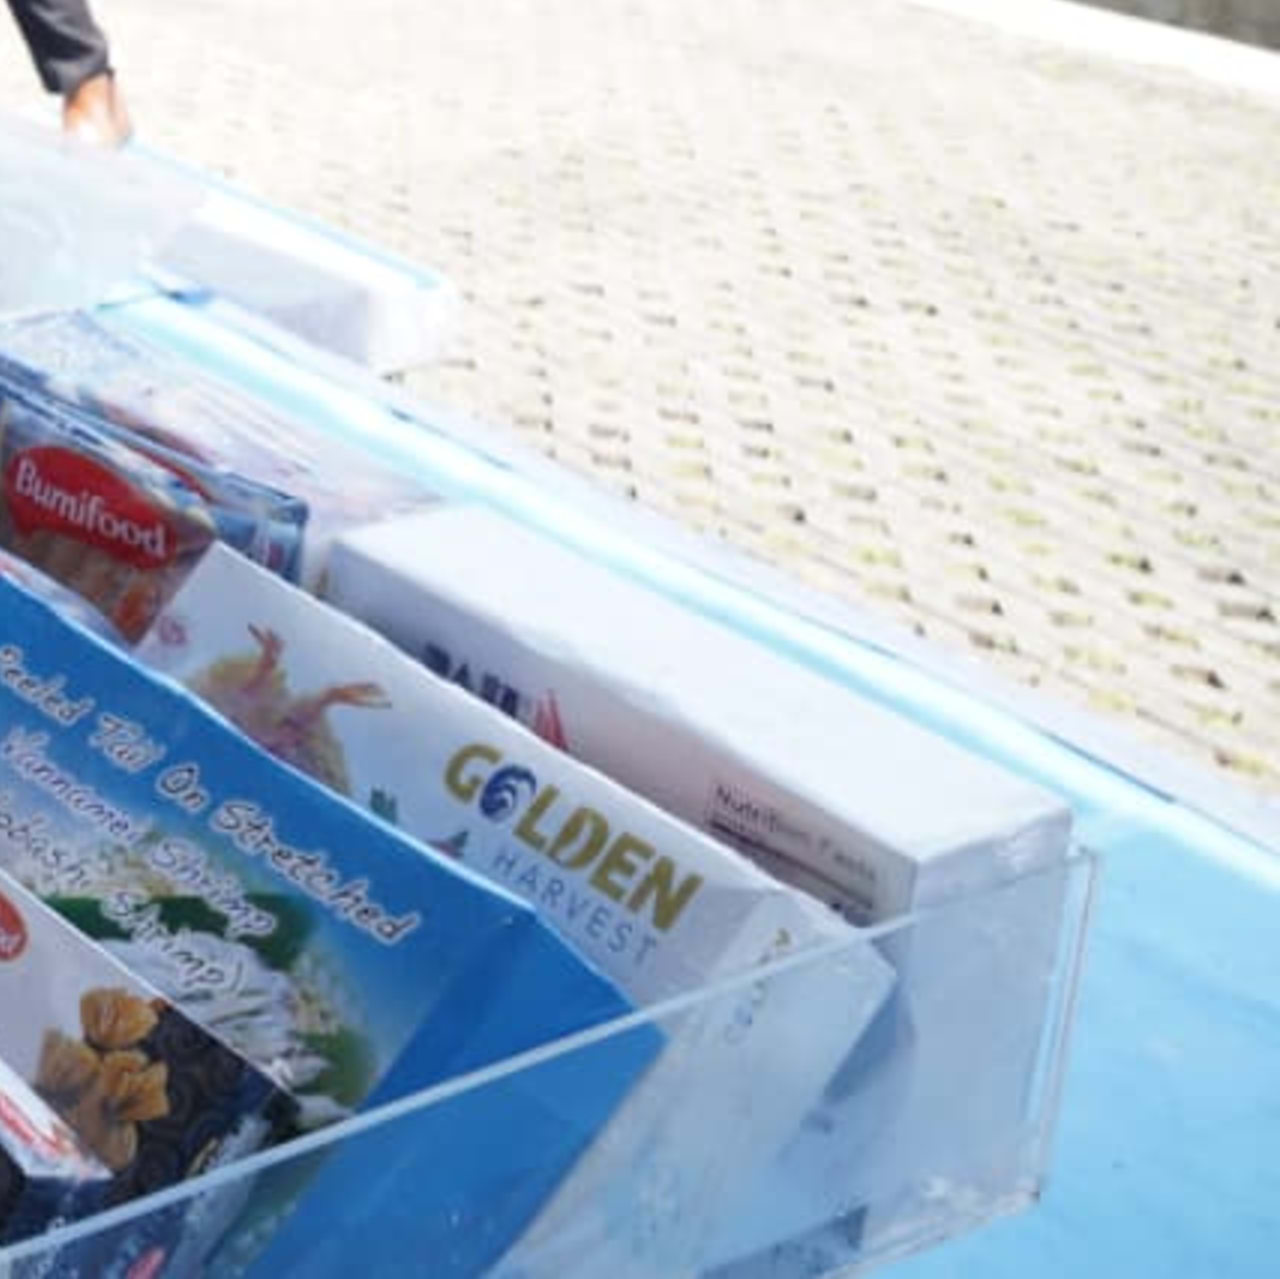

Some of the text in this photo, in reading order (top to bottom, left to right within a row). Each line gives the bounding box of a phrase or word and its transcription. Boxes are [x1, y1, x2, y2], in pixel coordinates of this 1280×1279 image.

[14, 459, 167, 560] Bumifood
[91, 713, 164, 771] Tail
[158, 763, 208, 812] On
[214, 800, 420, 942] Stretched
[445, 743, 703, 934] GOLDEN
[150, 838, 276, 937] Shrimp
[495, 850, 657, 961] HARVEST
